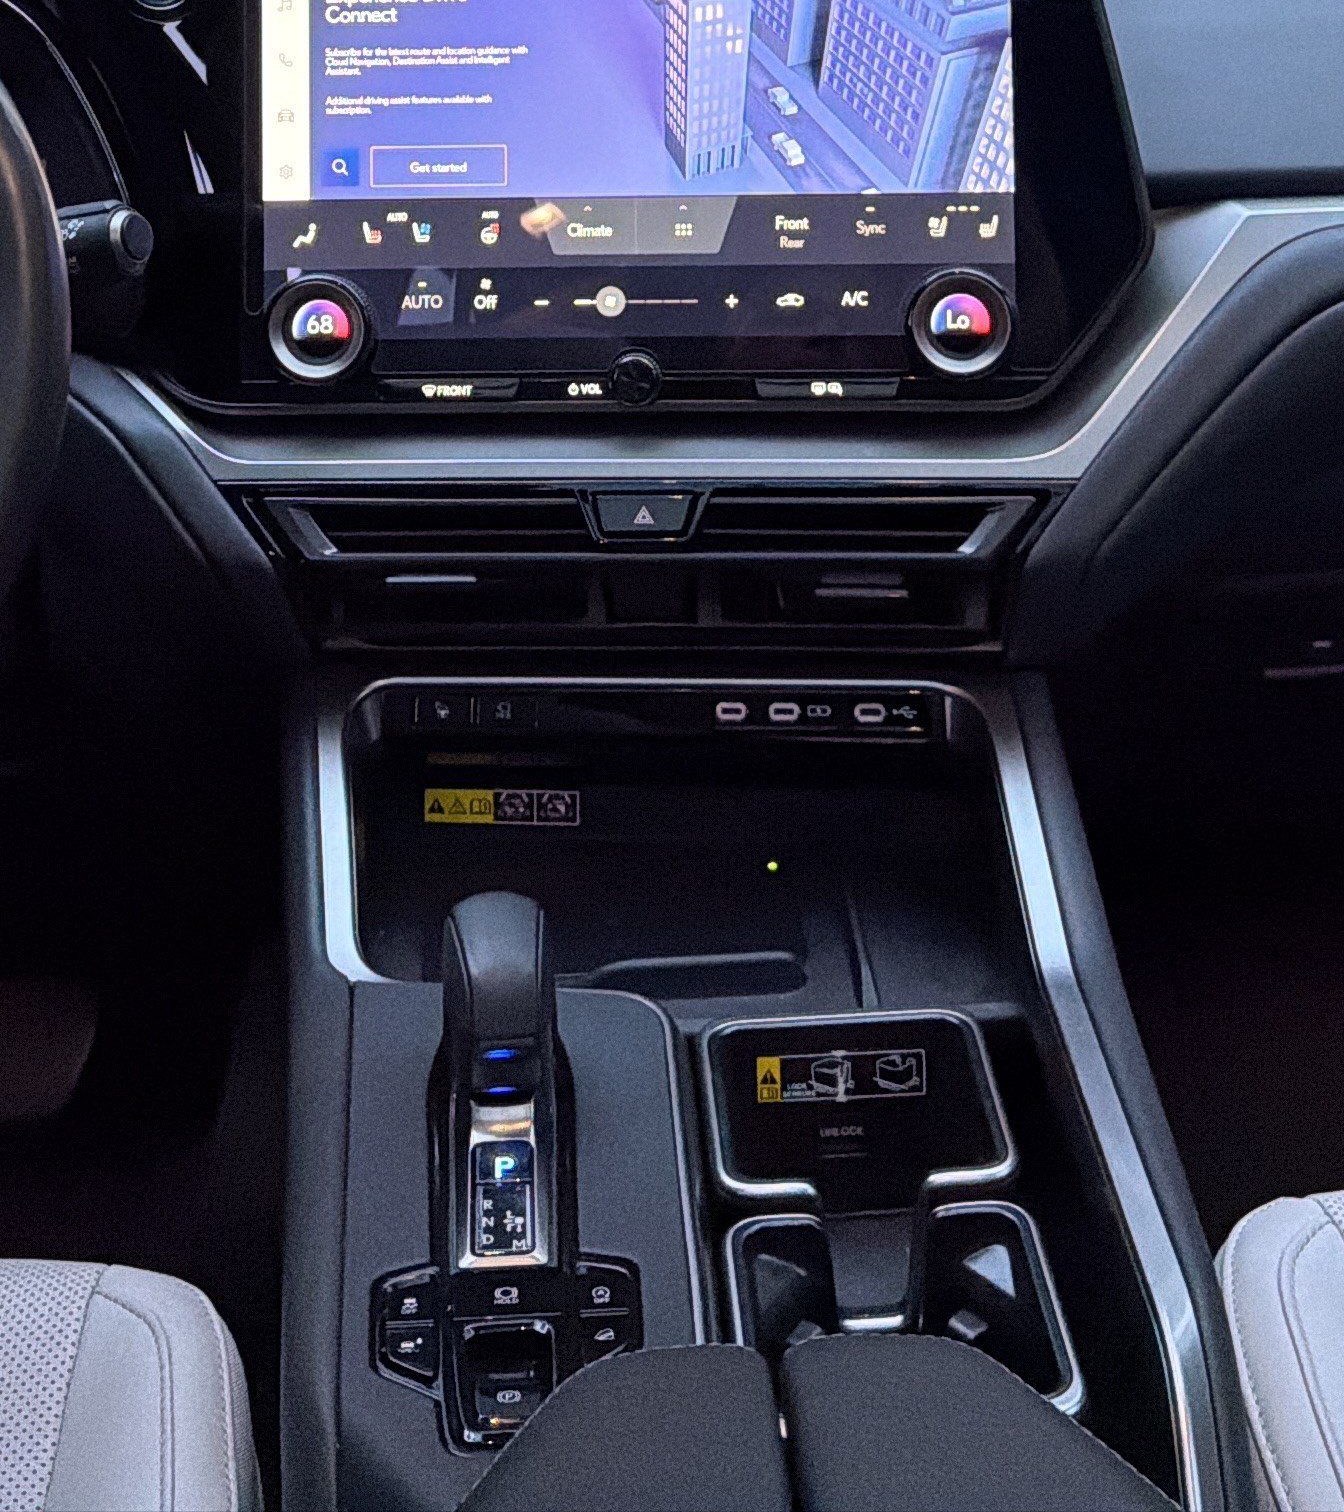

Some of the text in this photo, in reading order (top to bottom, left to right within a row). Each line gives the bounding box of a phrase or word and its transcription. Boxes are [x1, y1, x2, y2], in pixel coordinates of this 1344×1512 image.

[324, 5, 399, 24] Connect
[325, 47, 361, 56] Subscribe
[362, 46, 373, 56] for
[375, 46, 388, 56] the
[431, 46, 446, 55] and
[446, 46, 476, 55] location
[477, 45, 510, 56] guidance
[511, 45, 528, 55] with
[325, 57, 349, 66] Cloud
[393, 56, 436, 66] Destination
[436, 55, 458, 65] Assist
[459, 55, 473, 65] and
[474, 55, 511, 66] Intelligent
[325, 93, 493, 106] Additional driving assist features available with
[410, 161, 468, 174] Get started
[387, 211, 408, 222] AUTO
[482, 210, 499, 220] AUTO
[775, 215, 810, 231] Front
[856, 220, 886, 236] Sync
[566, 222, 614, 239] Climate
[779, 236, 805, 249] Rear
[401, 294, 443, 309] AUTO
[474, 294, 498, 310] Off
[841, 290, 869, 307] A/C
[306, 314, 334, 335] 68
[946, 309, 970, 330] Lo
[437, 384, 473, 397] FRONT
[580, 383, 603, 395] VOL
[494, 1155, 516, 1180] P
[483, 1199, 494, 1210] R
[482, 1216, 494, 1228] N
[482, 1233, 495, 1245] D
[512, 1238, 527, 1251] M
[494, 1297, 519, 1305] HOLD
[593, 1296, 610, 1304] OFF
